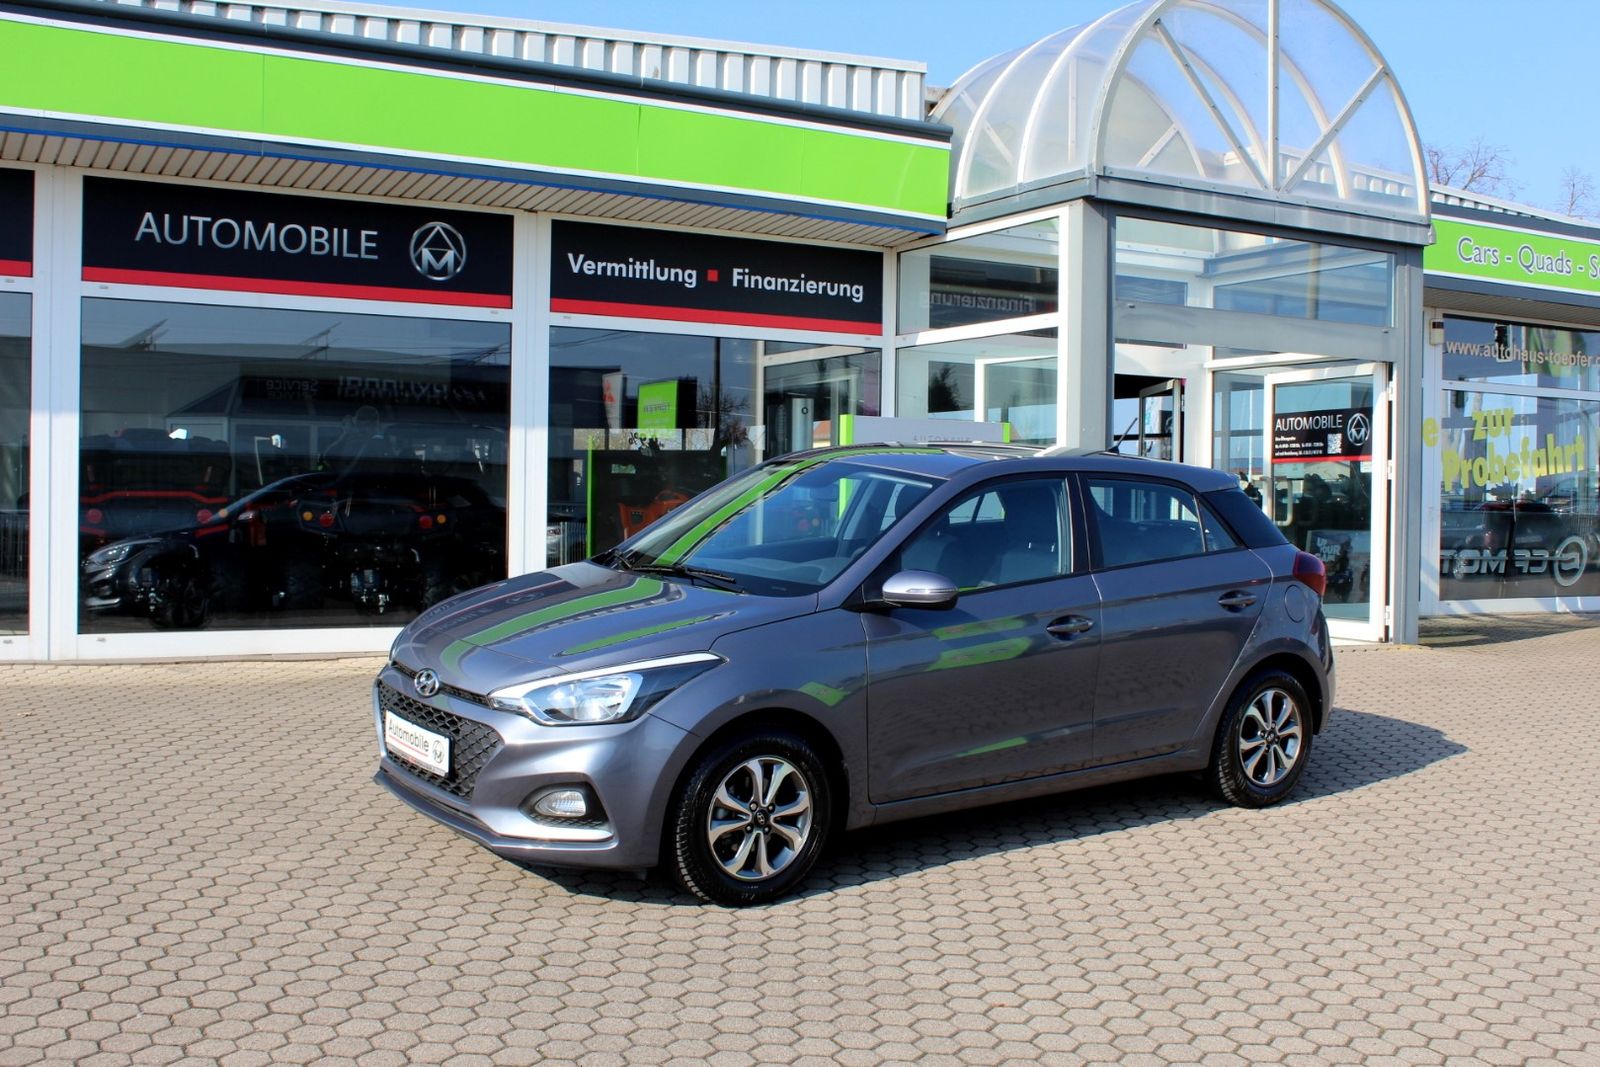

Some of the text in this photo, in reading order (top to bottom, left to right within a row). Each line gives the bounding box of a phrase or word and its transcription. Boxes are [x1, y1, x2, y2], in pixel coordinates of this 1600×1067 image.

[134, 211, 379, 260] AUTOMOBILE
[567, 252, 697, 288] Vermittlung
[1457, 236, 1500, 266] Cars
[1518, 244, 1572, 275] Quads
[1589, 254, 1600, 279] S
[732, 268, 864, 303] Finanzierung
[1275, 414, 1343, 432] AUTOMOBILE
[1472, 407, 1515, 441] zur
[1441, 433, 1585, 492] Probefahrt
[389, 719, 430, 752] Automobile
